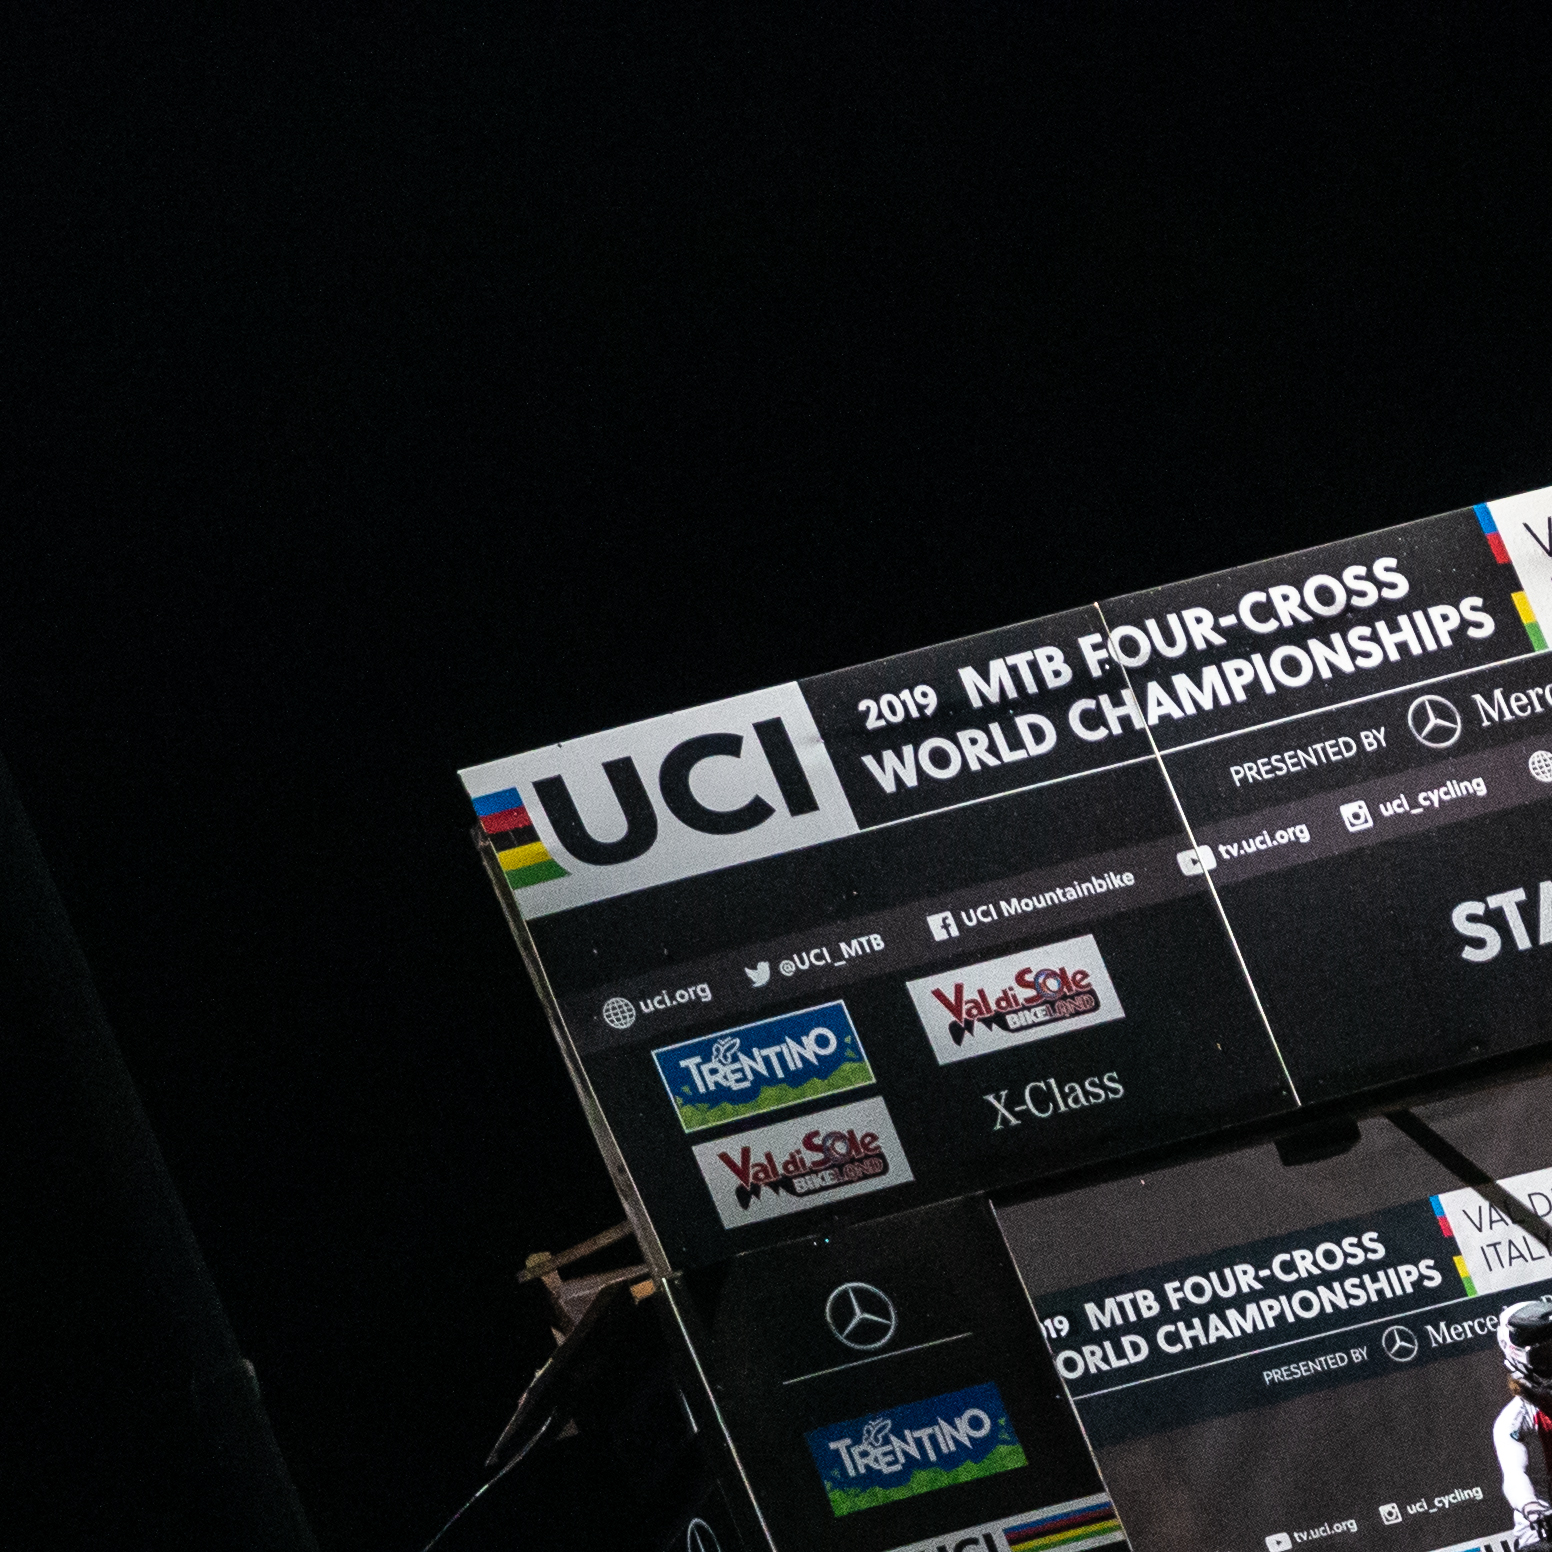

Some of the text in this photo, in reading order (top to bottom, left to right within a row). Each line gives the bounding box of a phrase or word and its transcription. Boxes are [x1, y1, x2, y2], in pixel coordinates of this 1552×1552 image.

[858, 556, 1410, 731] 2019 MTB FOUR-CROSS
[860, 597, 1495, 795] WORLD CHAMPIONSHIPS
[1229, 726, 1387, 786] PRESENTED BY
[531, 717, 820, 867] UCI
[1379, 774, 1487, 819] uci_cycling
[1218, 821, 1311, 862] tv.uci.org
[961, 869, 1135, 930] UCI Mountainbike
[778, 932, 885, 978] @UCI_MTB
[638, 980, 712, 1016] uci.org
[679, 1027, 837, 1094] TRENTINO
[983, 1069, 1125, 1131] X-Class
[1085, 1284, 1160, 1334] MTB
[1163, 1231, 1385, 1309] FOUR-CROSS
[1055, 1258, 1442, 1381] ORLD CHAMPIONSHIPS
[1263, 1346, 1369, 1387] PRESENTED BY
[829, 1407, 992, 1478] TRENTINO
[1405, 1485, 1484, 1516] uci_cycling
[1293, 1518, 1358, 1547] tv.uci.org
